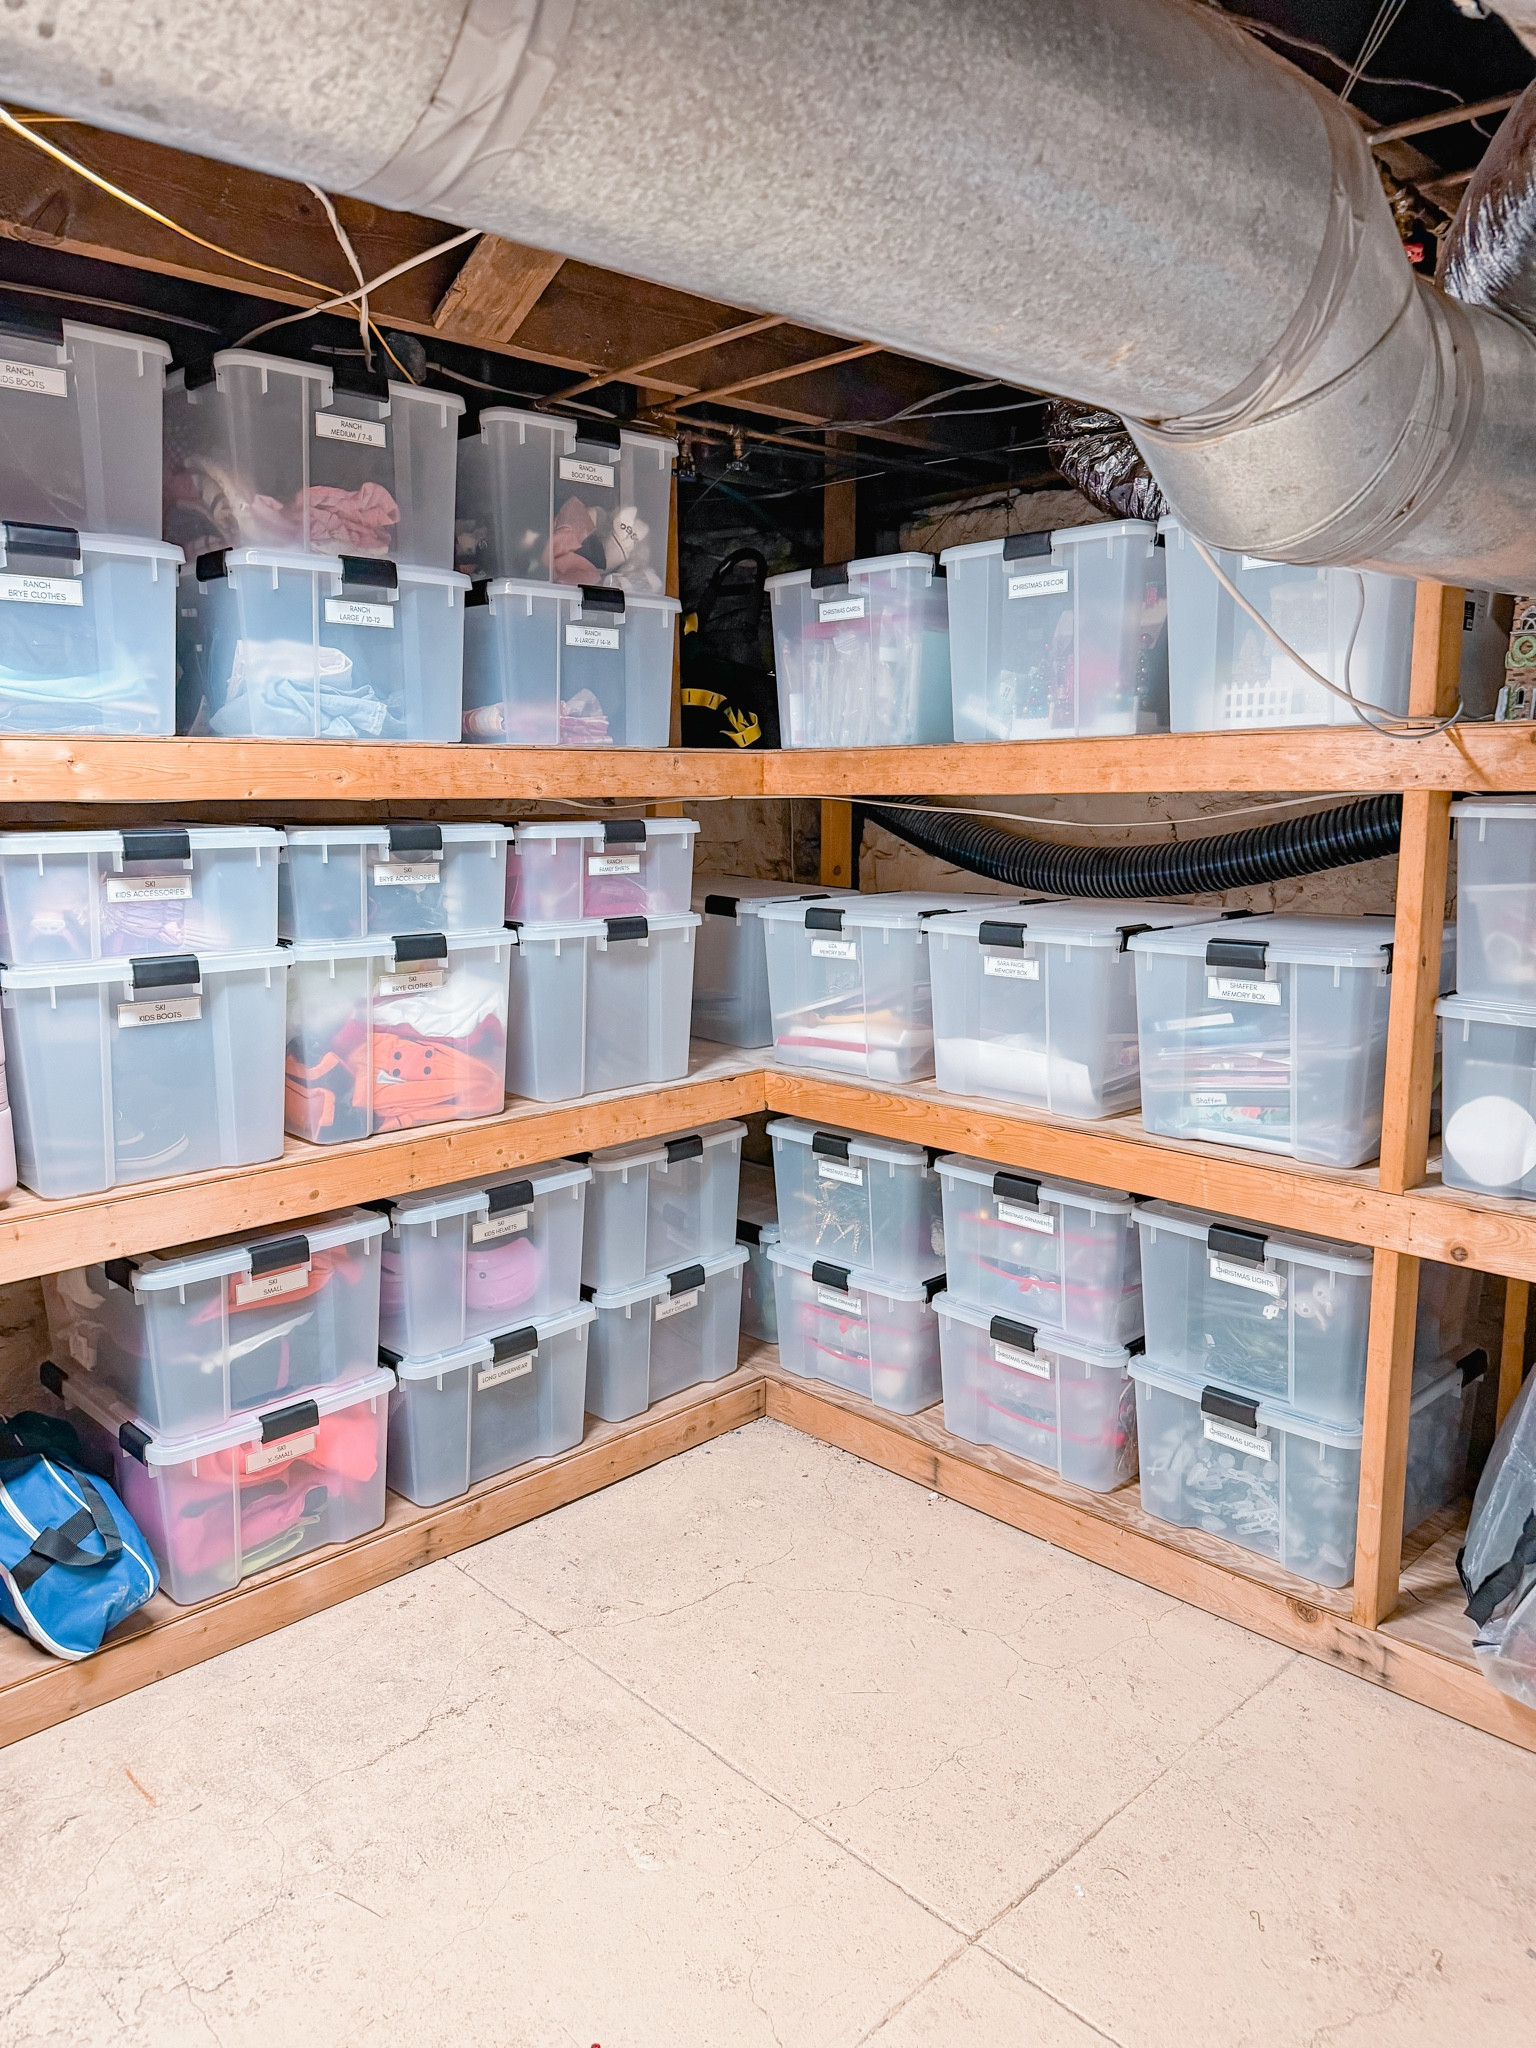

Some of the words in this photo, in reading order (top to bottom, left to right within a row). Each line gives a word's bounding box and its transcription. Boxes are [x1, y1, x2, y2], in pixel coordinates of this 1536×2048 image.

[6, 364, 35, 376] RANCH
[0, 375, 15, 384] IDS
[16, 377, 45, 390] BOOTS
[340, 420, 363, 430] RANCH
[330, 429, 357, 438] MEDIUM
[362, 433, 373, 442] 7-8
[578, 464, 597, 473] RANCH
[571, 471, 586, 480] BOOT
[22, 579, 51, 590] RANCH
[1012, 582, 1043, 591] CHRISTMAS
[1043, 578, 1064, 588] DECOR
[8, 589, 29, 598] BRYE
[30, 590, 67, 601] CLOTHES
[349, 605, 371, 614] RANCH
[822, 607, 846, 616] CHRISTMAS
[339, 613, 360, 622] LARGE
[366, 615, 381, 624] 10-12
[584, 629, 602, 637] RANCH
[403, 866, 413, 874] SKI
[379, 875, 395, 883] BRYE
[395, 873, 436, 882] ACCESSORIES
[145, 880, 156, 889] SKI
[115, 890, 132, 899] KIDS
[133, 888, 186, 898] ACCESSORIES
[996, 959, 1010, 967] SARA
[1010, 961, 1025, 969] PAIGE
[994, 967, 1017, 976] MEMORY
[392, 984, 407, 993] BRYE
[407, 981, 433, 991] CLOTHES
[1229, 982, 1258, 992] SHAFFER
[1221, 989, 1251, 999] MEMORY
[1252, 992, 1267, 1001] BOX
[154, 1004, 166, 1013] SKI
[138, 1013, 155, 1023] KIDS
[156, 1011, 182, 1022] BOOTS
[497, 1219, 505, 1227] SKI
[484, 1227, 497, 1238] KIDS
[497, 1223, 518, 1234] HELMETS
[268, 1278, 278, 1286] SKI
[1215, 1265, 1251, 1282] CHRISTMAS
[1251, 1275, 1275, 1288] LIGHTS
[263, 1285, 283, 1296] SMALL
[482, 1371, 497, 1385] LONG
[497, 1361, 528, 1378] UNDERWEAR
[1208, 1427, 1243, 1446] CHRISTMAS
[1243, 1440, 1266, 1454] LIGHTS
[276, 1444, 287, 1453] SKI
[266, 1450, 294, 1464] X-SMALL
